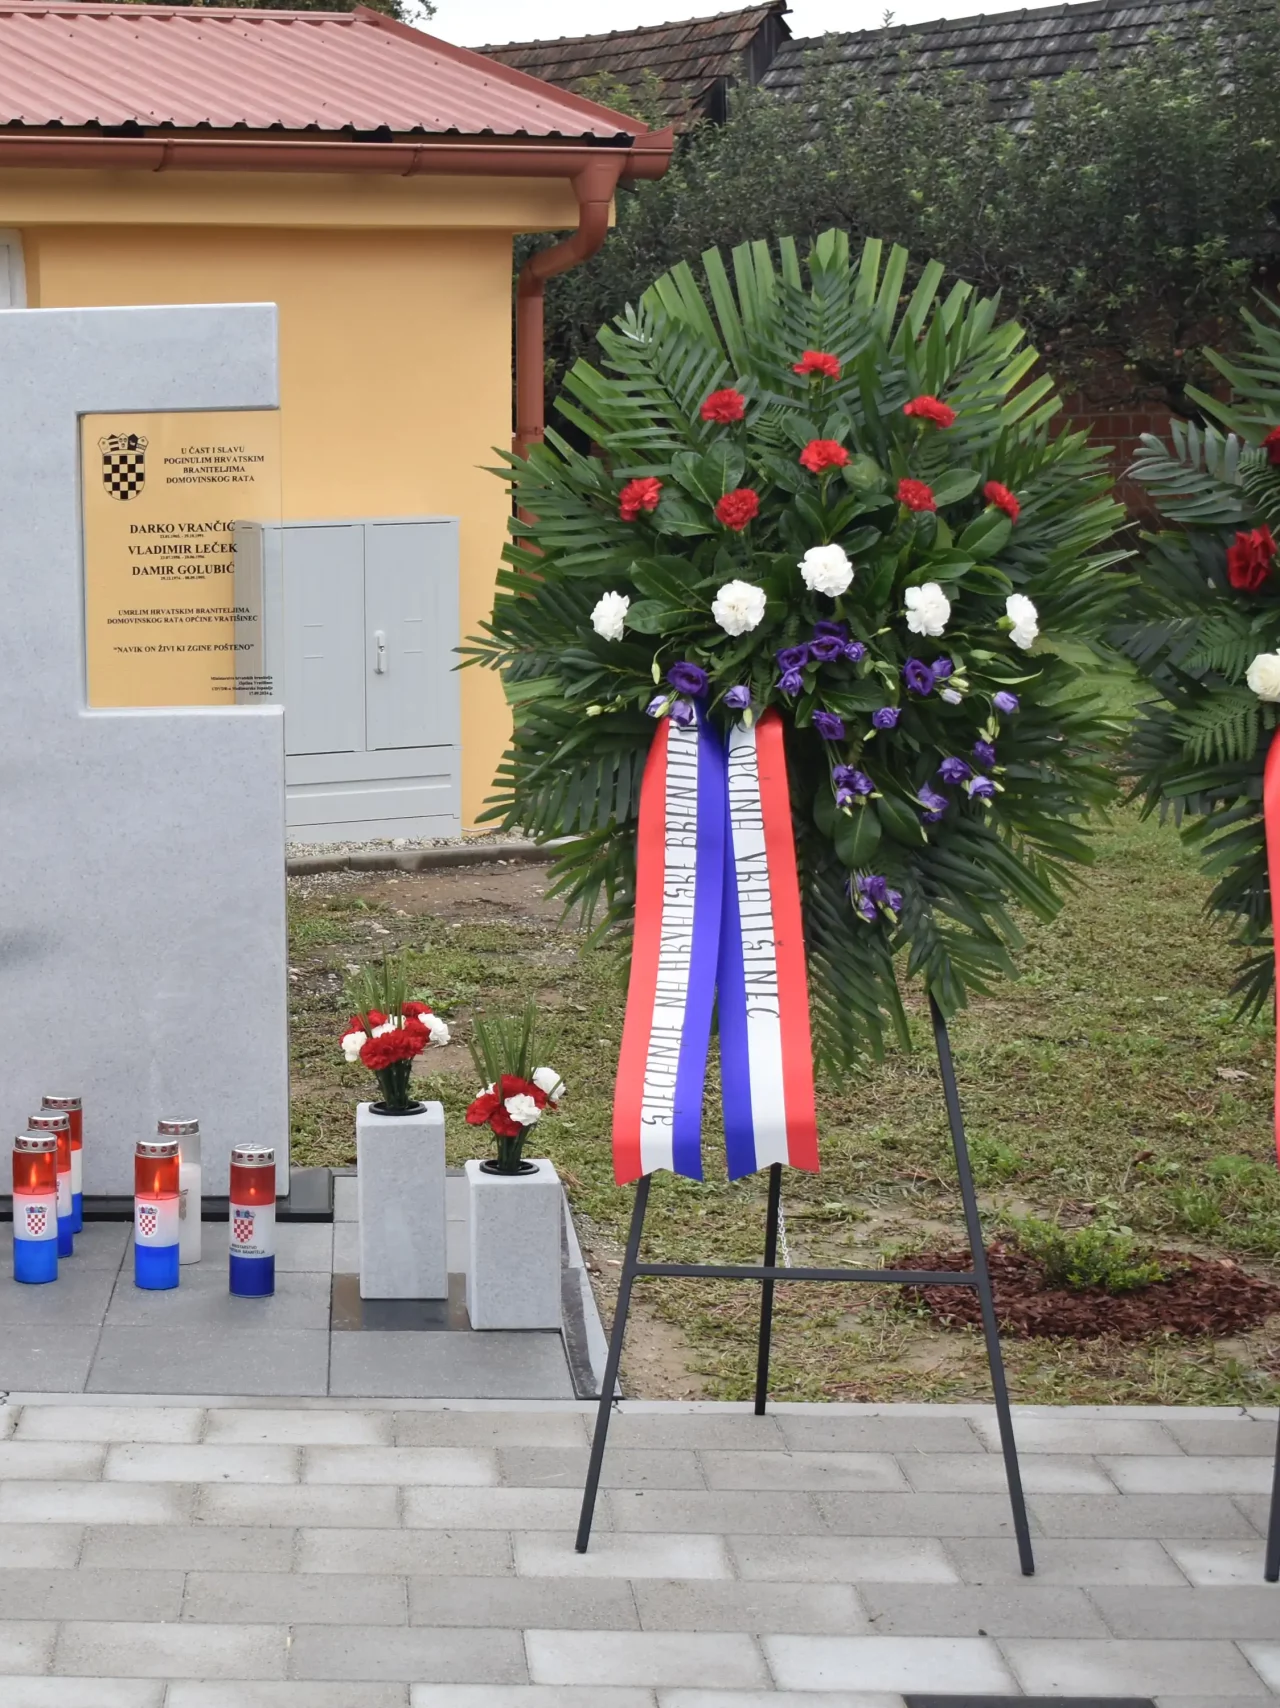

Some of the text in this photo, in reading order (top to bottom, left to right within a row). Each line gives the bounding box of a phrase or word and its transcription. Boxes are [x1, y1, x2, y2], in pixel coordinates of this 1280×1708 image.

[181, 447, 187, 455] U
[188, 446, 210, 454] ČAST
[217, 446, 245, 454] SLAVU
[214, 455, 265, 463] HRVATSKIM
[183, 466, 246, 474] BRANITELJIMA
[166, 475, 230, 484] DOMOVINSKOG
[130, 519, 236, 534] DARKO VRANČIĆ
[128, 541, 238, 555] VLADIMIR LEČEK
[132, 561, 235, 576] DAMIR GOLUBIĆ
[107, 617, 163, 625] DOMOVINSKOG
[214, 614, 259, 622] VRATIŠINEC
[158, 644, 175, 652] ŽIVI
[187, 644, 212, 652] ZGINE
[658, 863, 696, 971] HRVATSKE
[734, 851, 784, 1019] VRATIŠINEC
[654, 980, 688, 1009] NA
